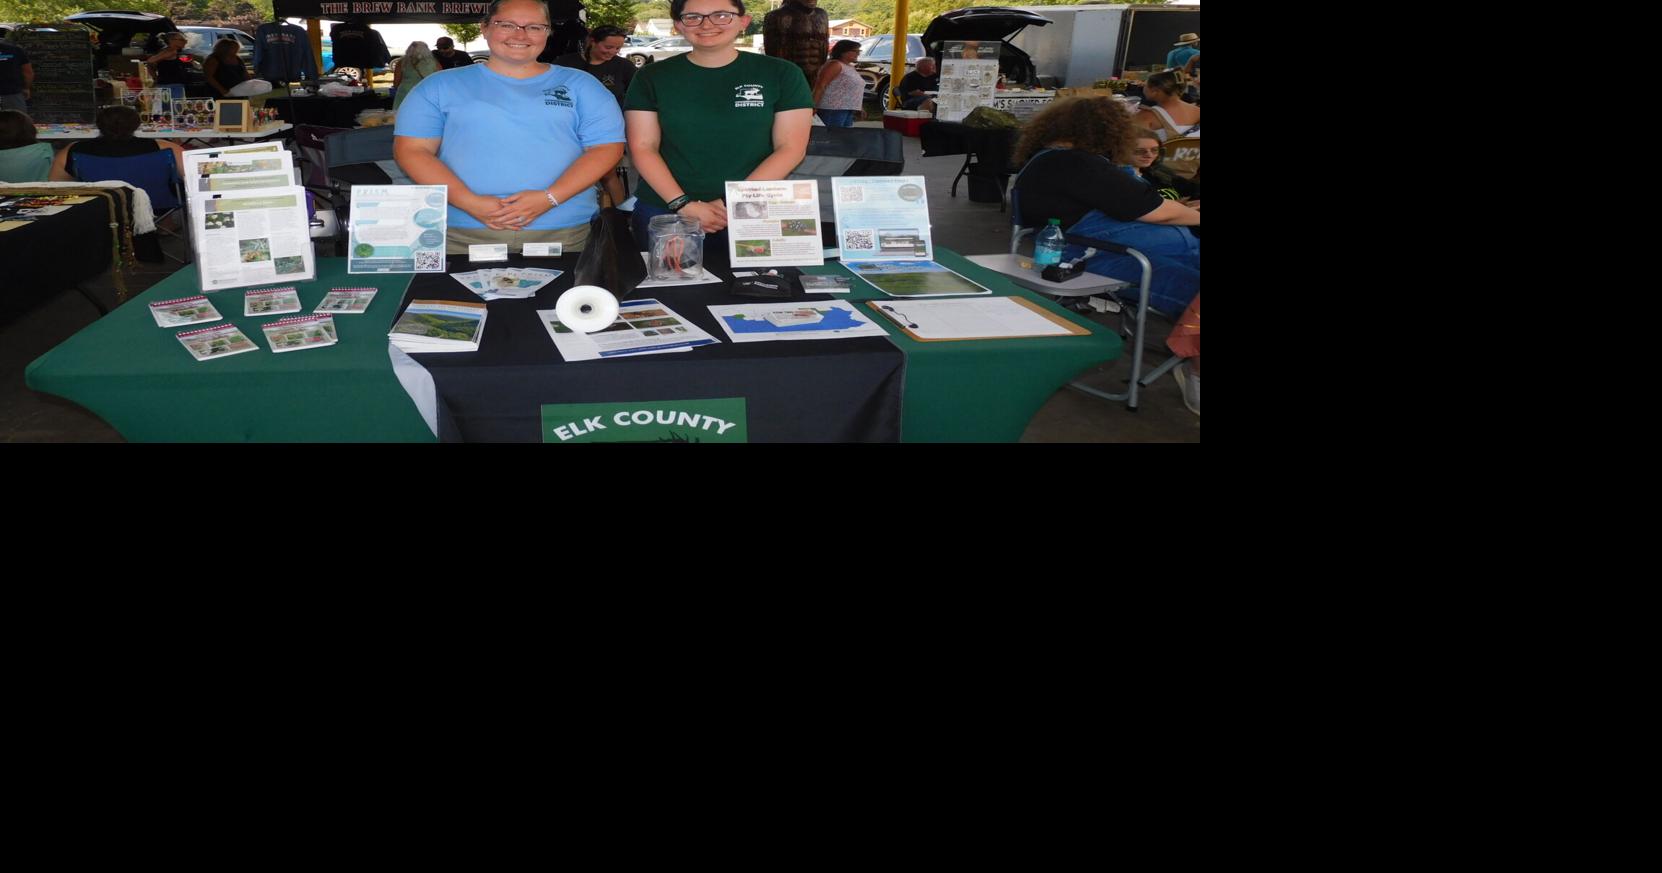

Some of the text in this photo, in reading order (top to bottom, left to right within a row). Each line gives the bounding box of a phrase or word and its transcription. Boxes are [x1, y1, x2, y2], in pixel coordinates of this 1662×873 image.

[321, 2, 348, 14] THE
[352, 2, 393, 13] BREW
[396, 2, 436, 13] BANK
[553, 410, 736, 441] ELK COUNTY
